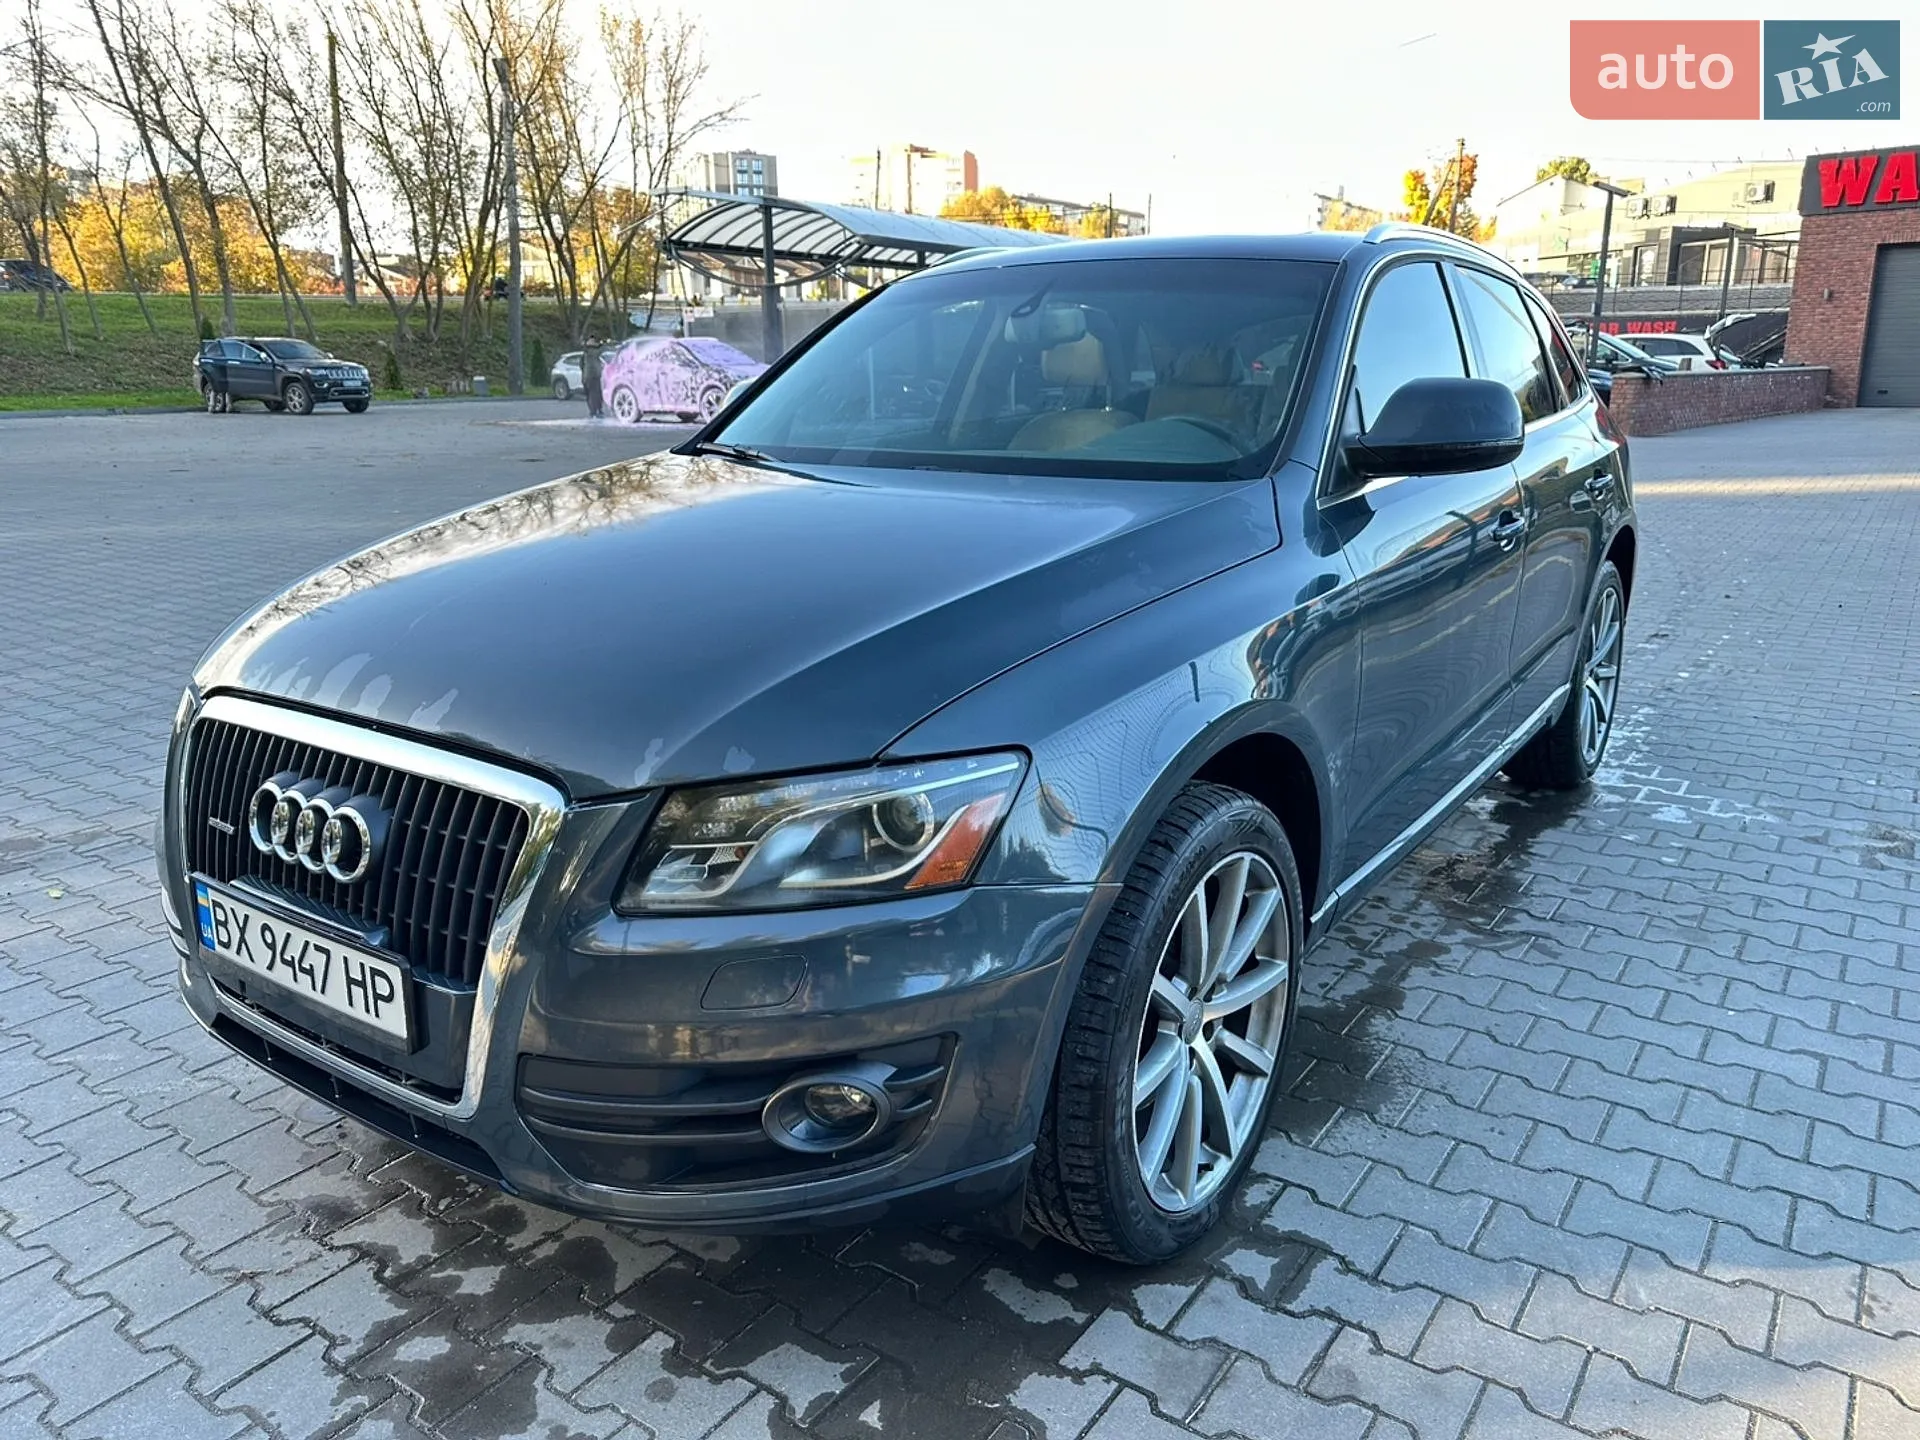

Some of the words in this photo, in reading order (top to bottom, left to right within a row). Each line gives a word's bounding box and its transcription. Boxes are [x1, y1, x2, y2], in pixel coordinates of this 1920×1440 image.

[1589, 321, 1619, 336] AR
[1627, 320, 1677, 333] WASH
[201, 922, 214, 941] UA
[211, 899, 255, 964] BX
[260, 922, 331, 995] 9447
[343, 955, 395, 1018] HP
